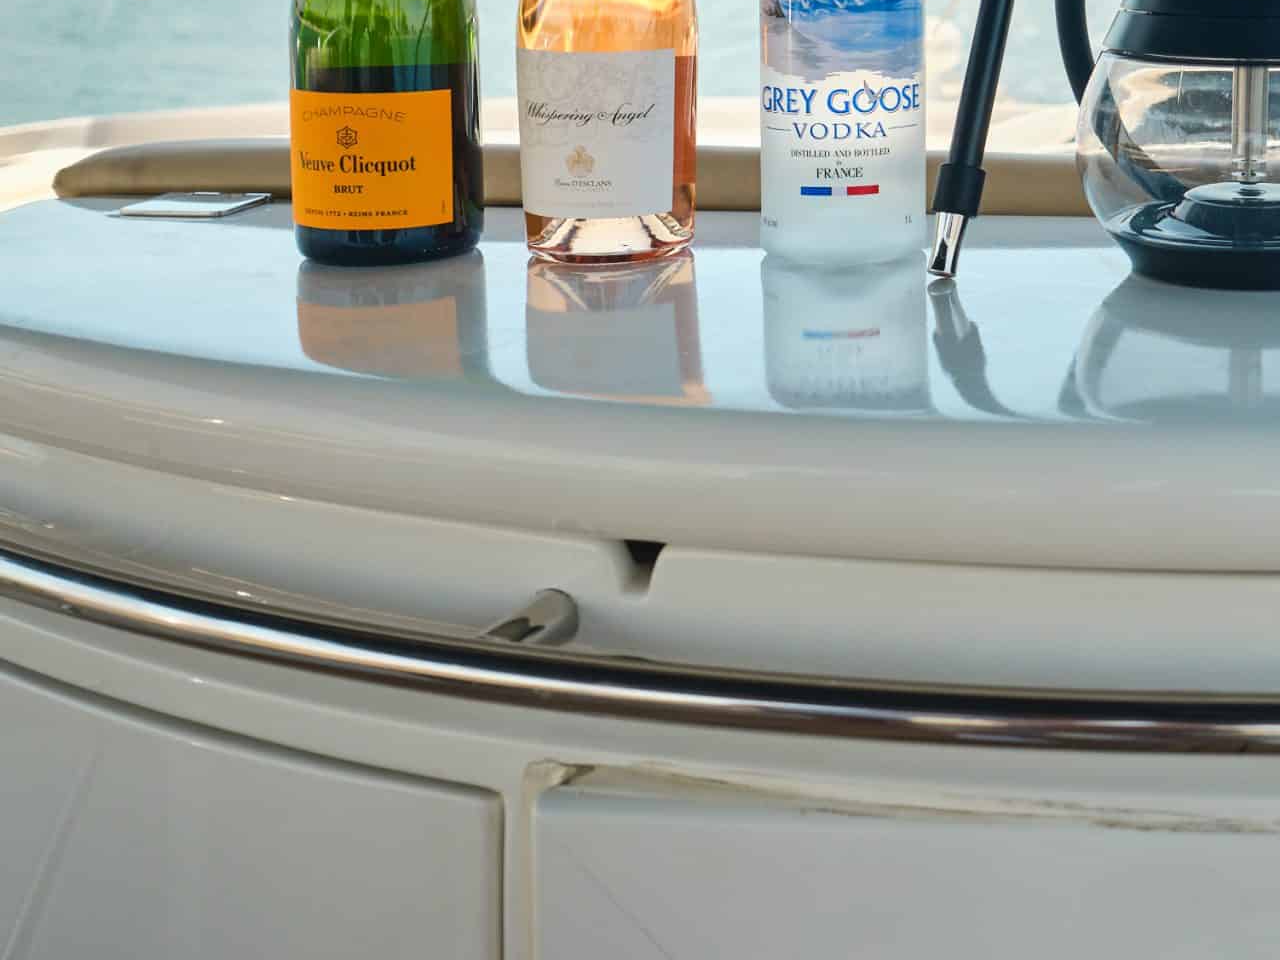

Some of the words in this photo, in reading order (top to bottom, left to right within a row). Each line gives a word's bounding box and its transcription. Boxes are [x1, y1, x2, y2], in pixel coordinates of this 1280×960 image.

[762, 85, 817, 115] GREY
[826, 83, 920, 115] GOOSE
[302, 105, 408, 123] CHAMPAGNE
[526, 100, 594, 127] Whispering
[597, 102, 655, 127] Angel
[792, 121, 887, 140] VODKA
[791, 149, 831, 158] DISTILLED
[834, 150, 851, 158] AND
[854, 147, 890, 158] BOTTLED
[300, 150, 335, 173] Veuve
[339, 154, 416, 176] Clicquot
[816, 167, 864, 179] FRANCE
[333, 183, 365, 194] BRUT
